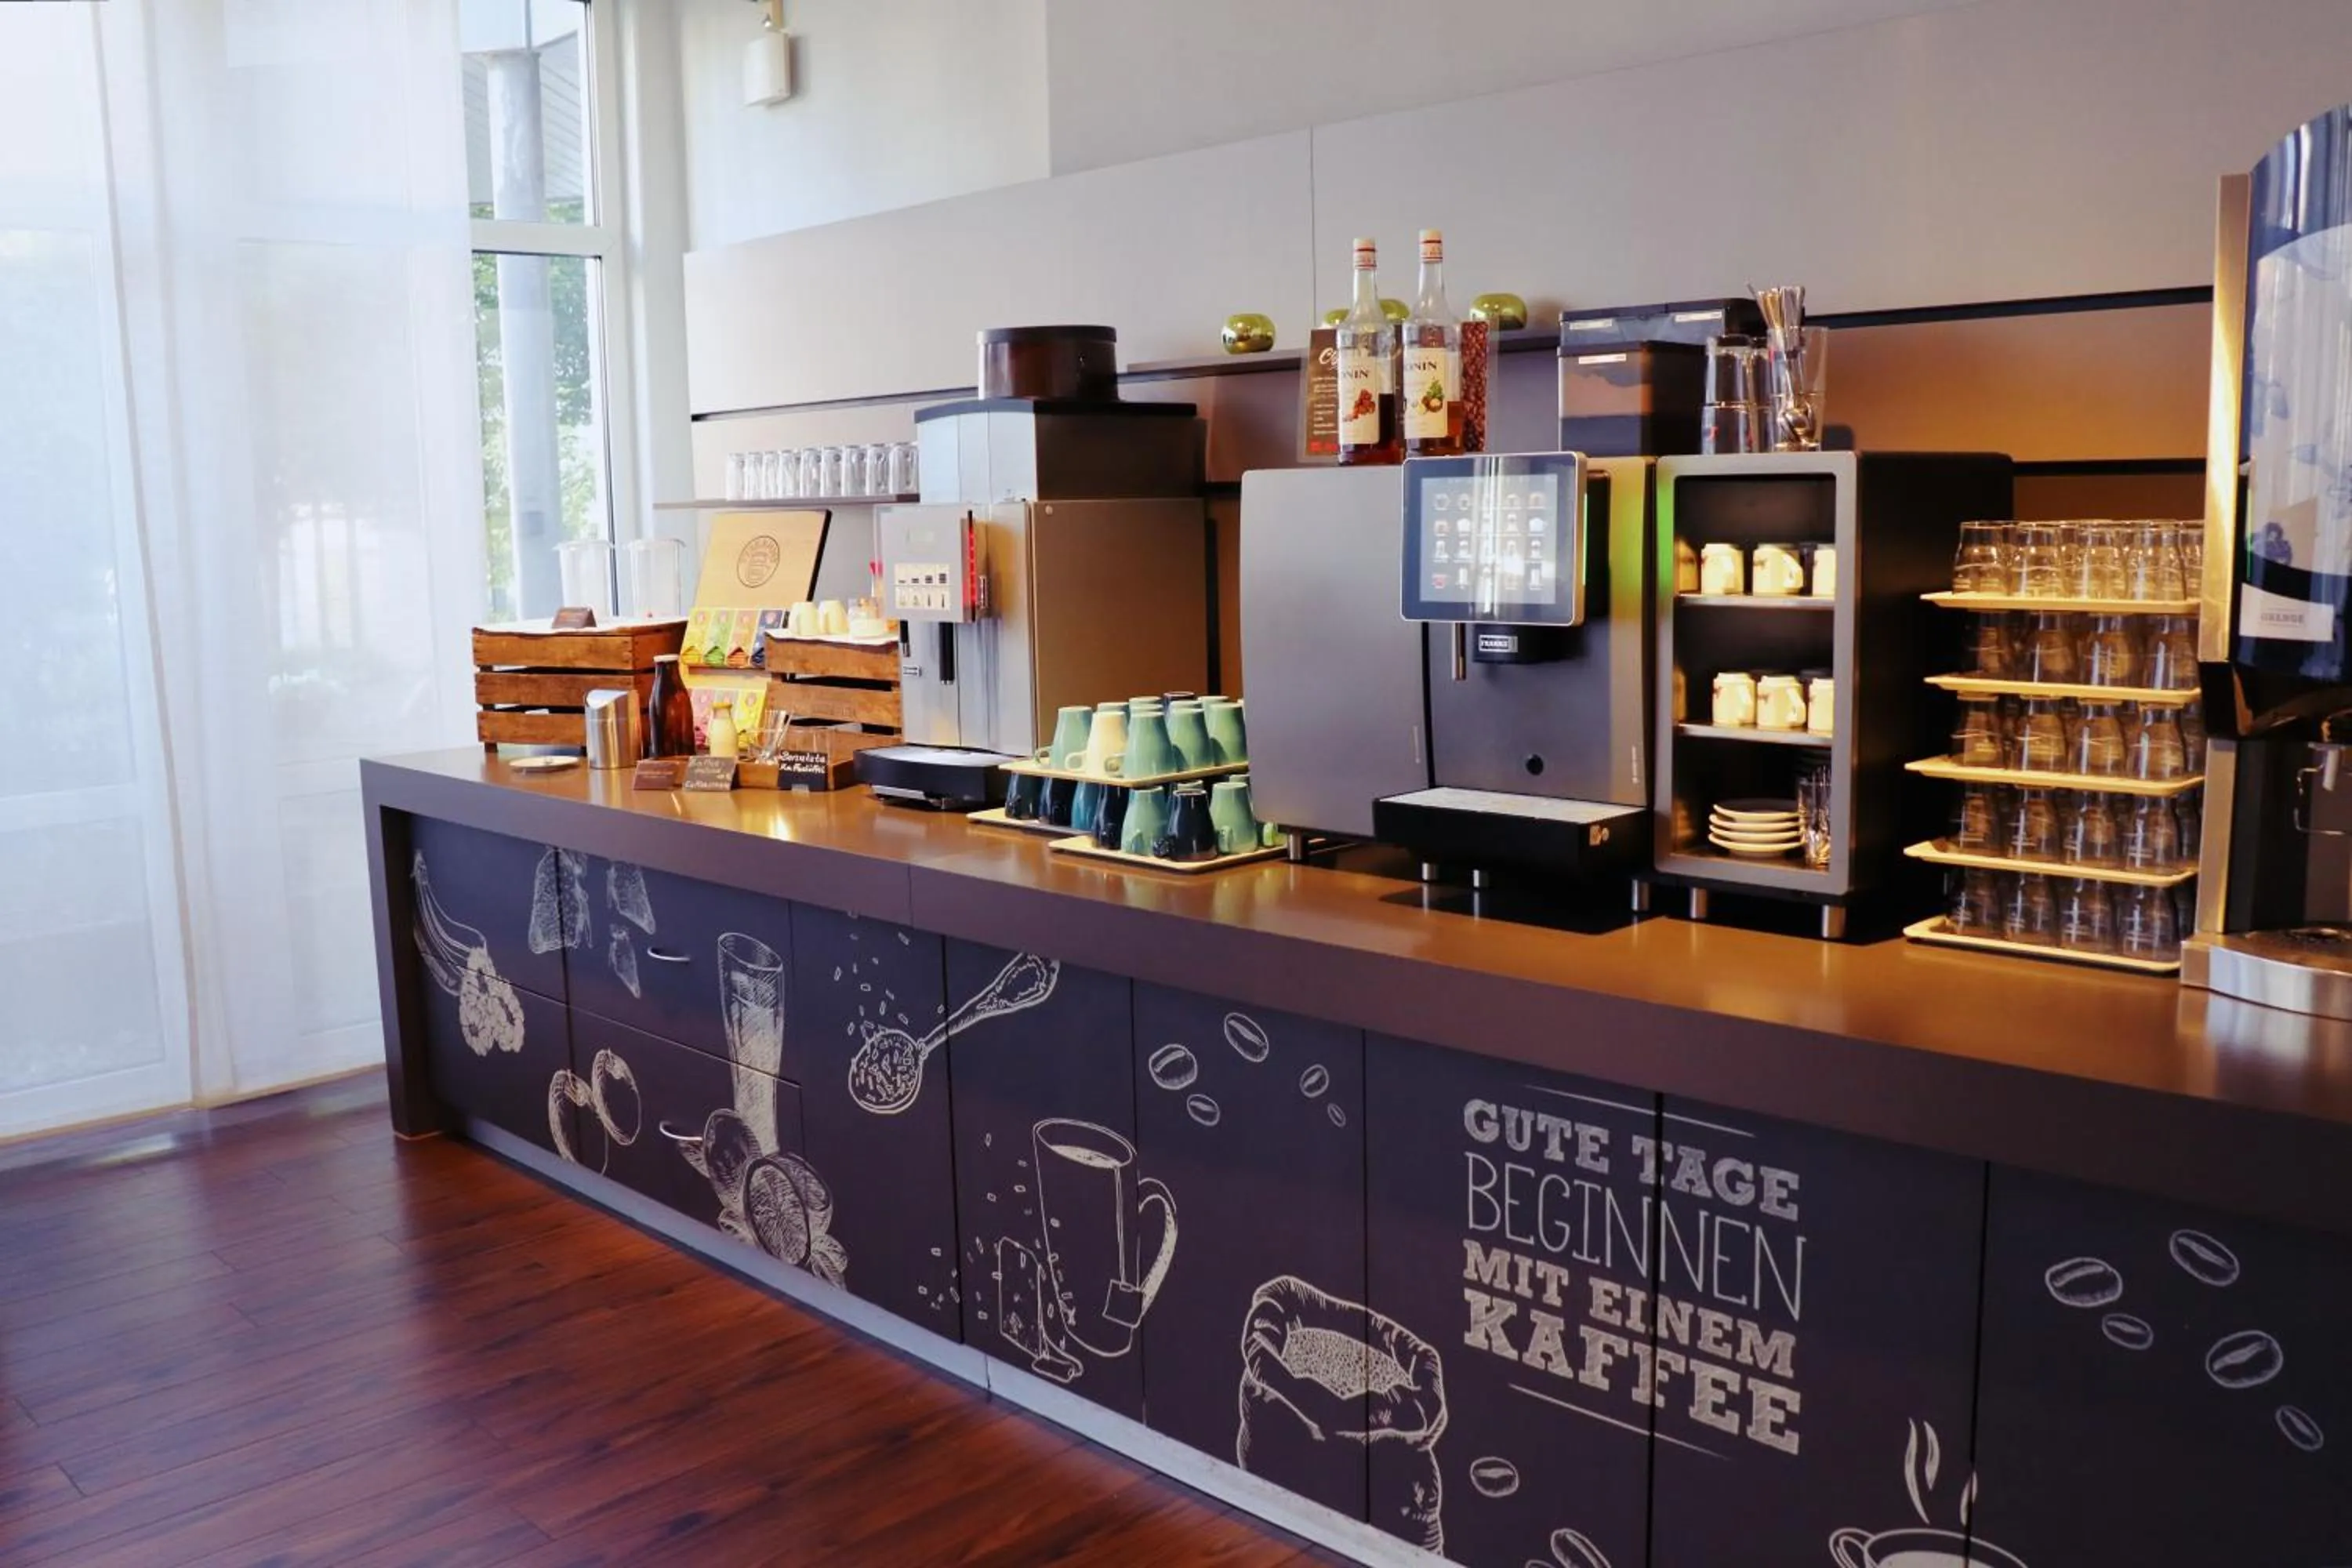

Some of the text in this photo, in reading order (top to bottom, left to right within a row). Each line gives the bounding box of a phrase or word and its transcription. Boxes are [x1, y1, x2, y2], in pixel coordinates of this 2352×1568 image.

[1464, 1098, 1799, 1221] GUTE TAGE
[1463, 1239, 1797, 1378] MIT EINEM
[1465, 1151, 1806, 1322] BEGINNEN
[1464, 1288, 1801, 1456] KAFFEE
